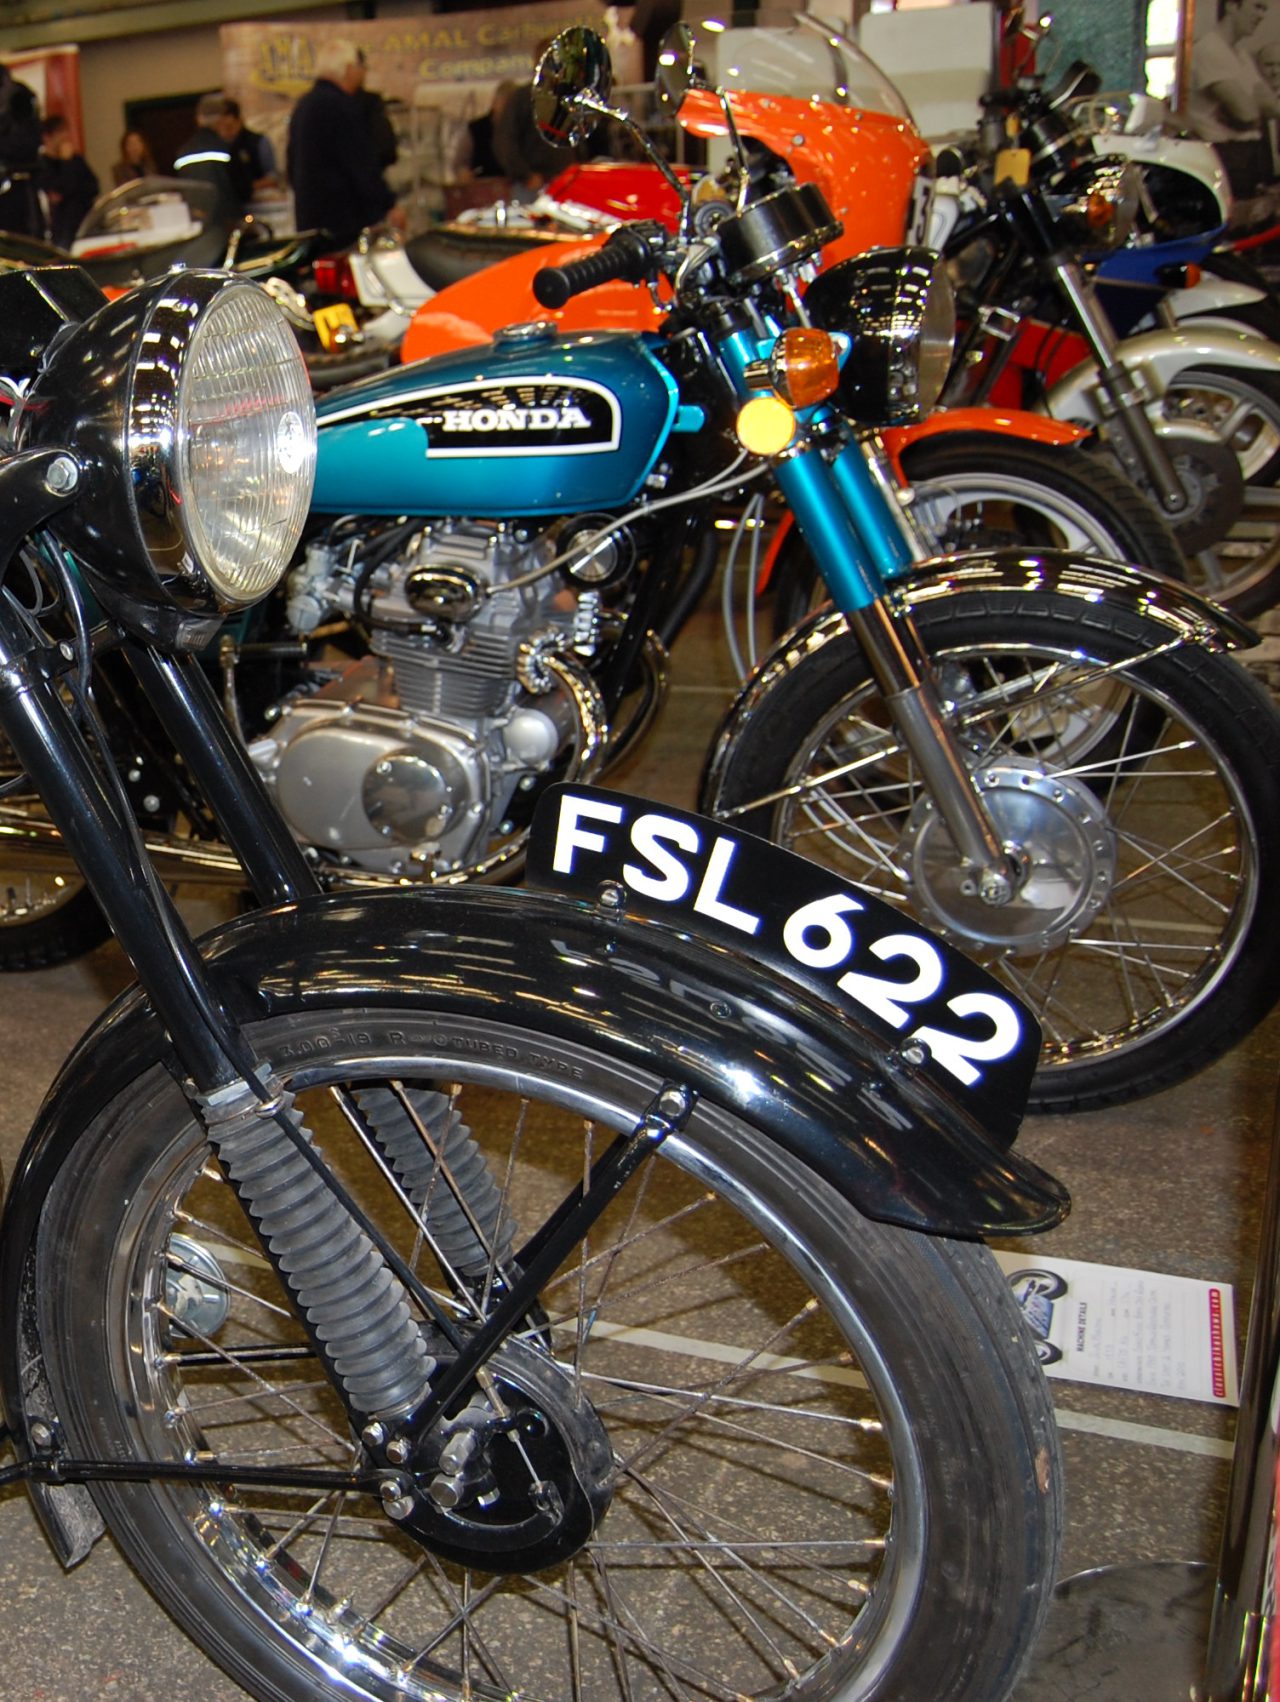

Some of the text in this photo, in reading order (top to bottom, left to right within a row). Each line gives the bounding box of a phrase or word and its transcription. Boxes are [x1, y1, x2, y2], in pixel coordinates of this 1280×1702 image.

[442, 406, 591, 432] HONDA
[552, 793, 1024, 1087] FSL 622
[451, 1036, 585, 1080] TUBED TYPE
